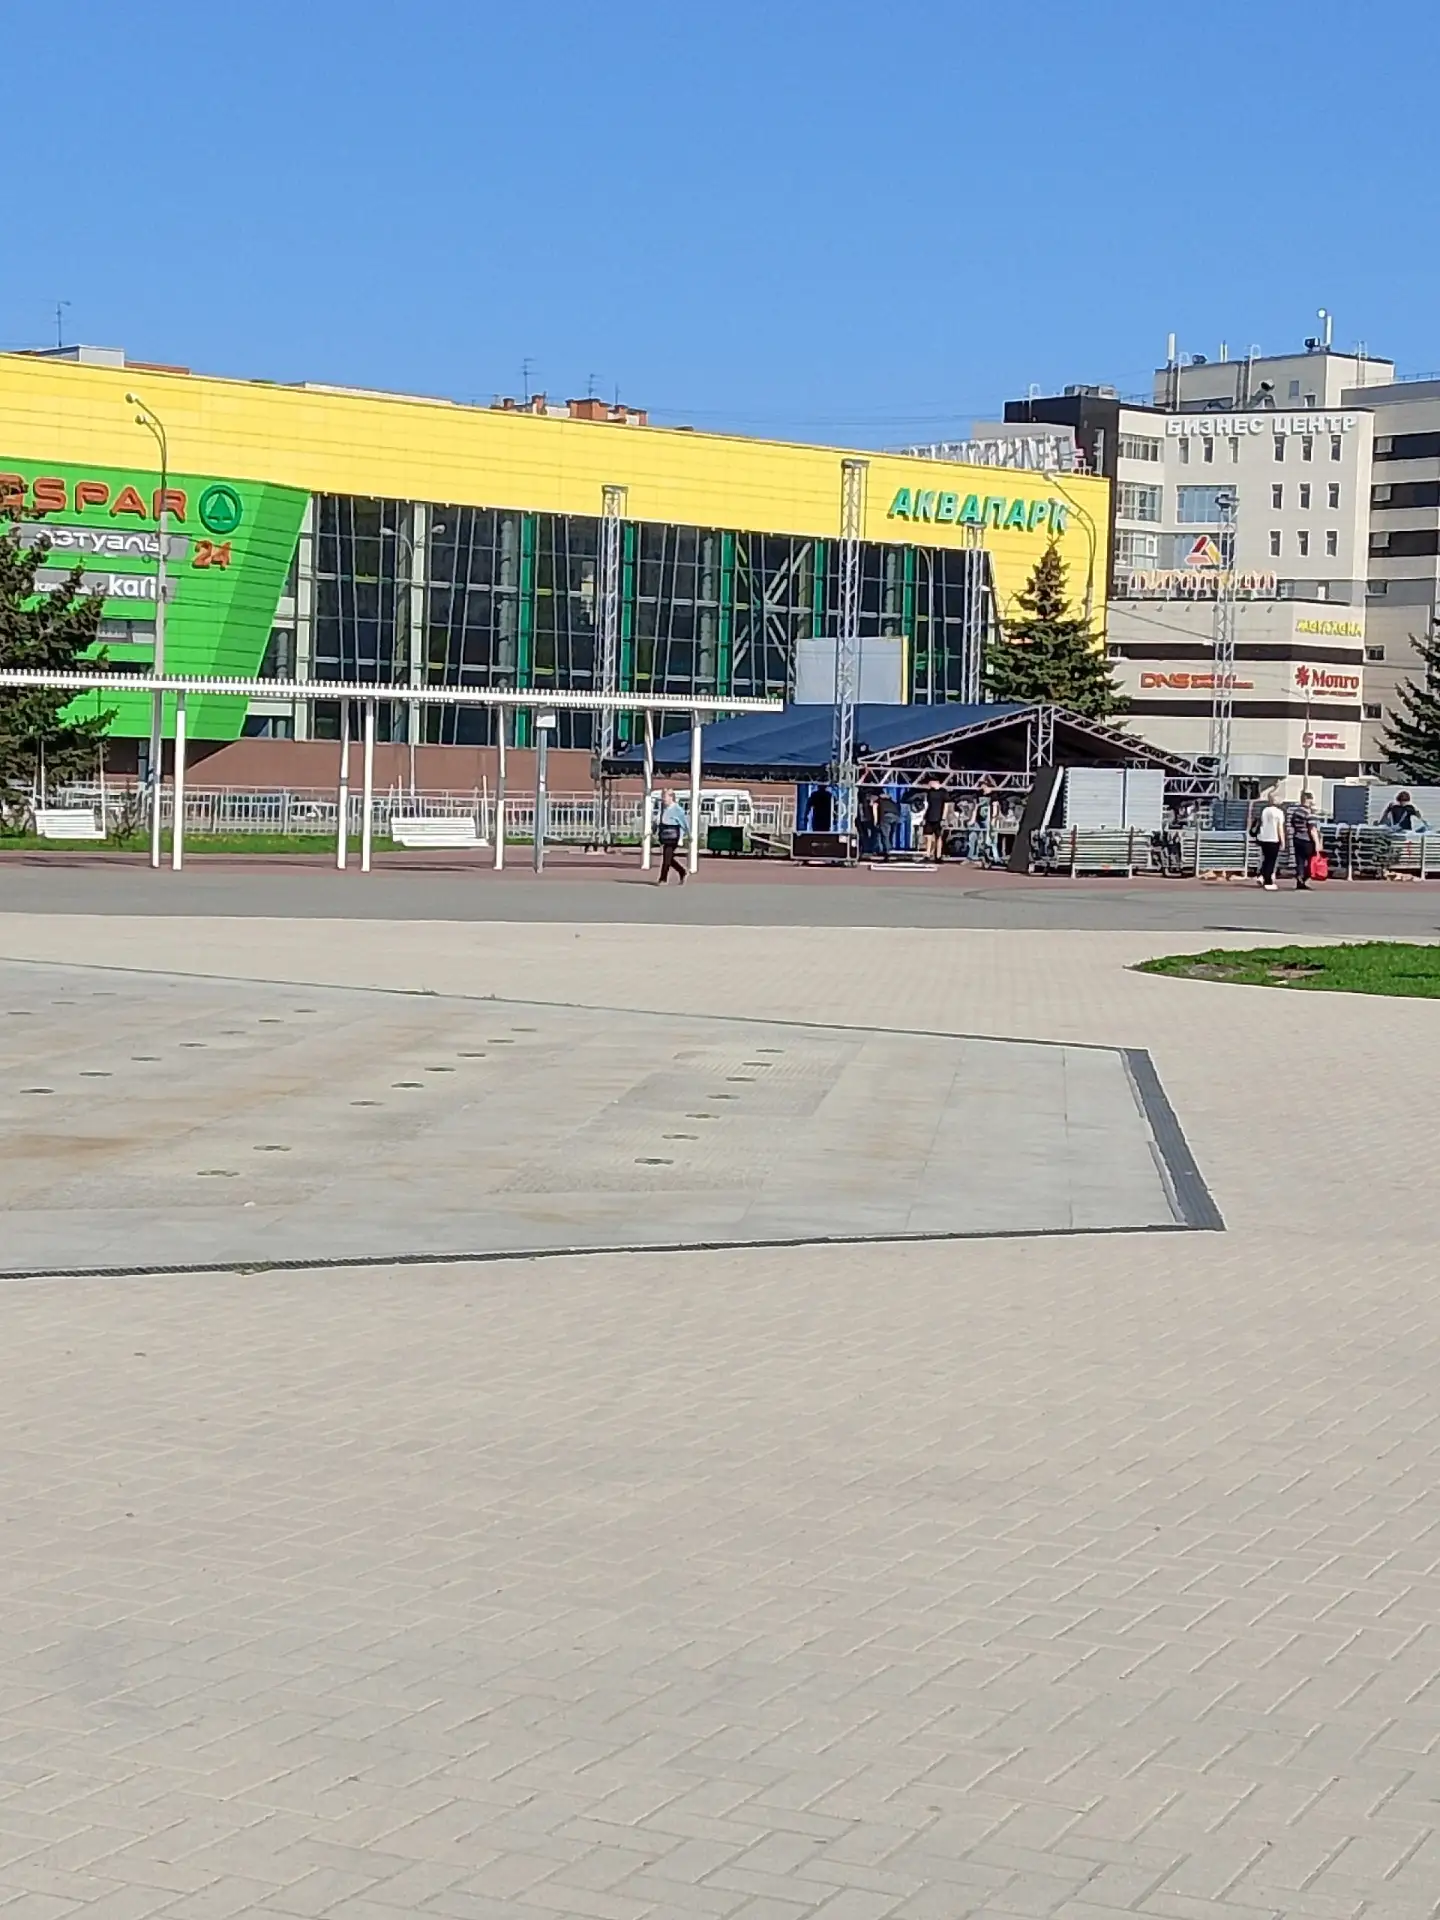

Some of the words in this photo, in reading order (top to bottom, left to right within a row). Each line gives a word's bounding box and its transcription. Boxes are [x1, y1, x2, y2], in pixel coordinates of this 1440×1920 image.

[1166, 416, 1265, 437] БИЗНЕС
[1271, 415, 1357, 437] ЦЕНТР
[887, 486, 1068, 536] АКВАПАРК
[192, 540, 232, 570] 24
[109, 574, 157, 599] kari
[1140, 672, 1190, 690] DNS
[1311, 668, 1360, 690] Monro
